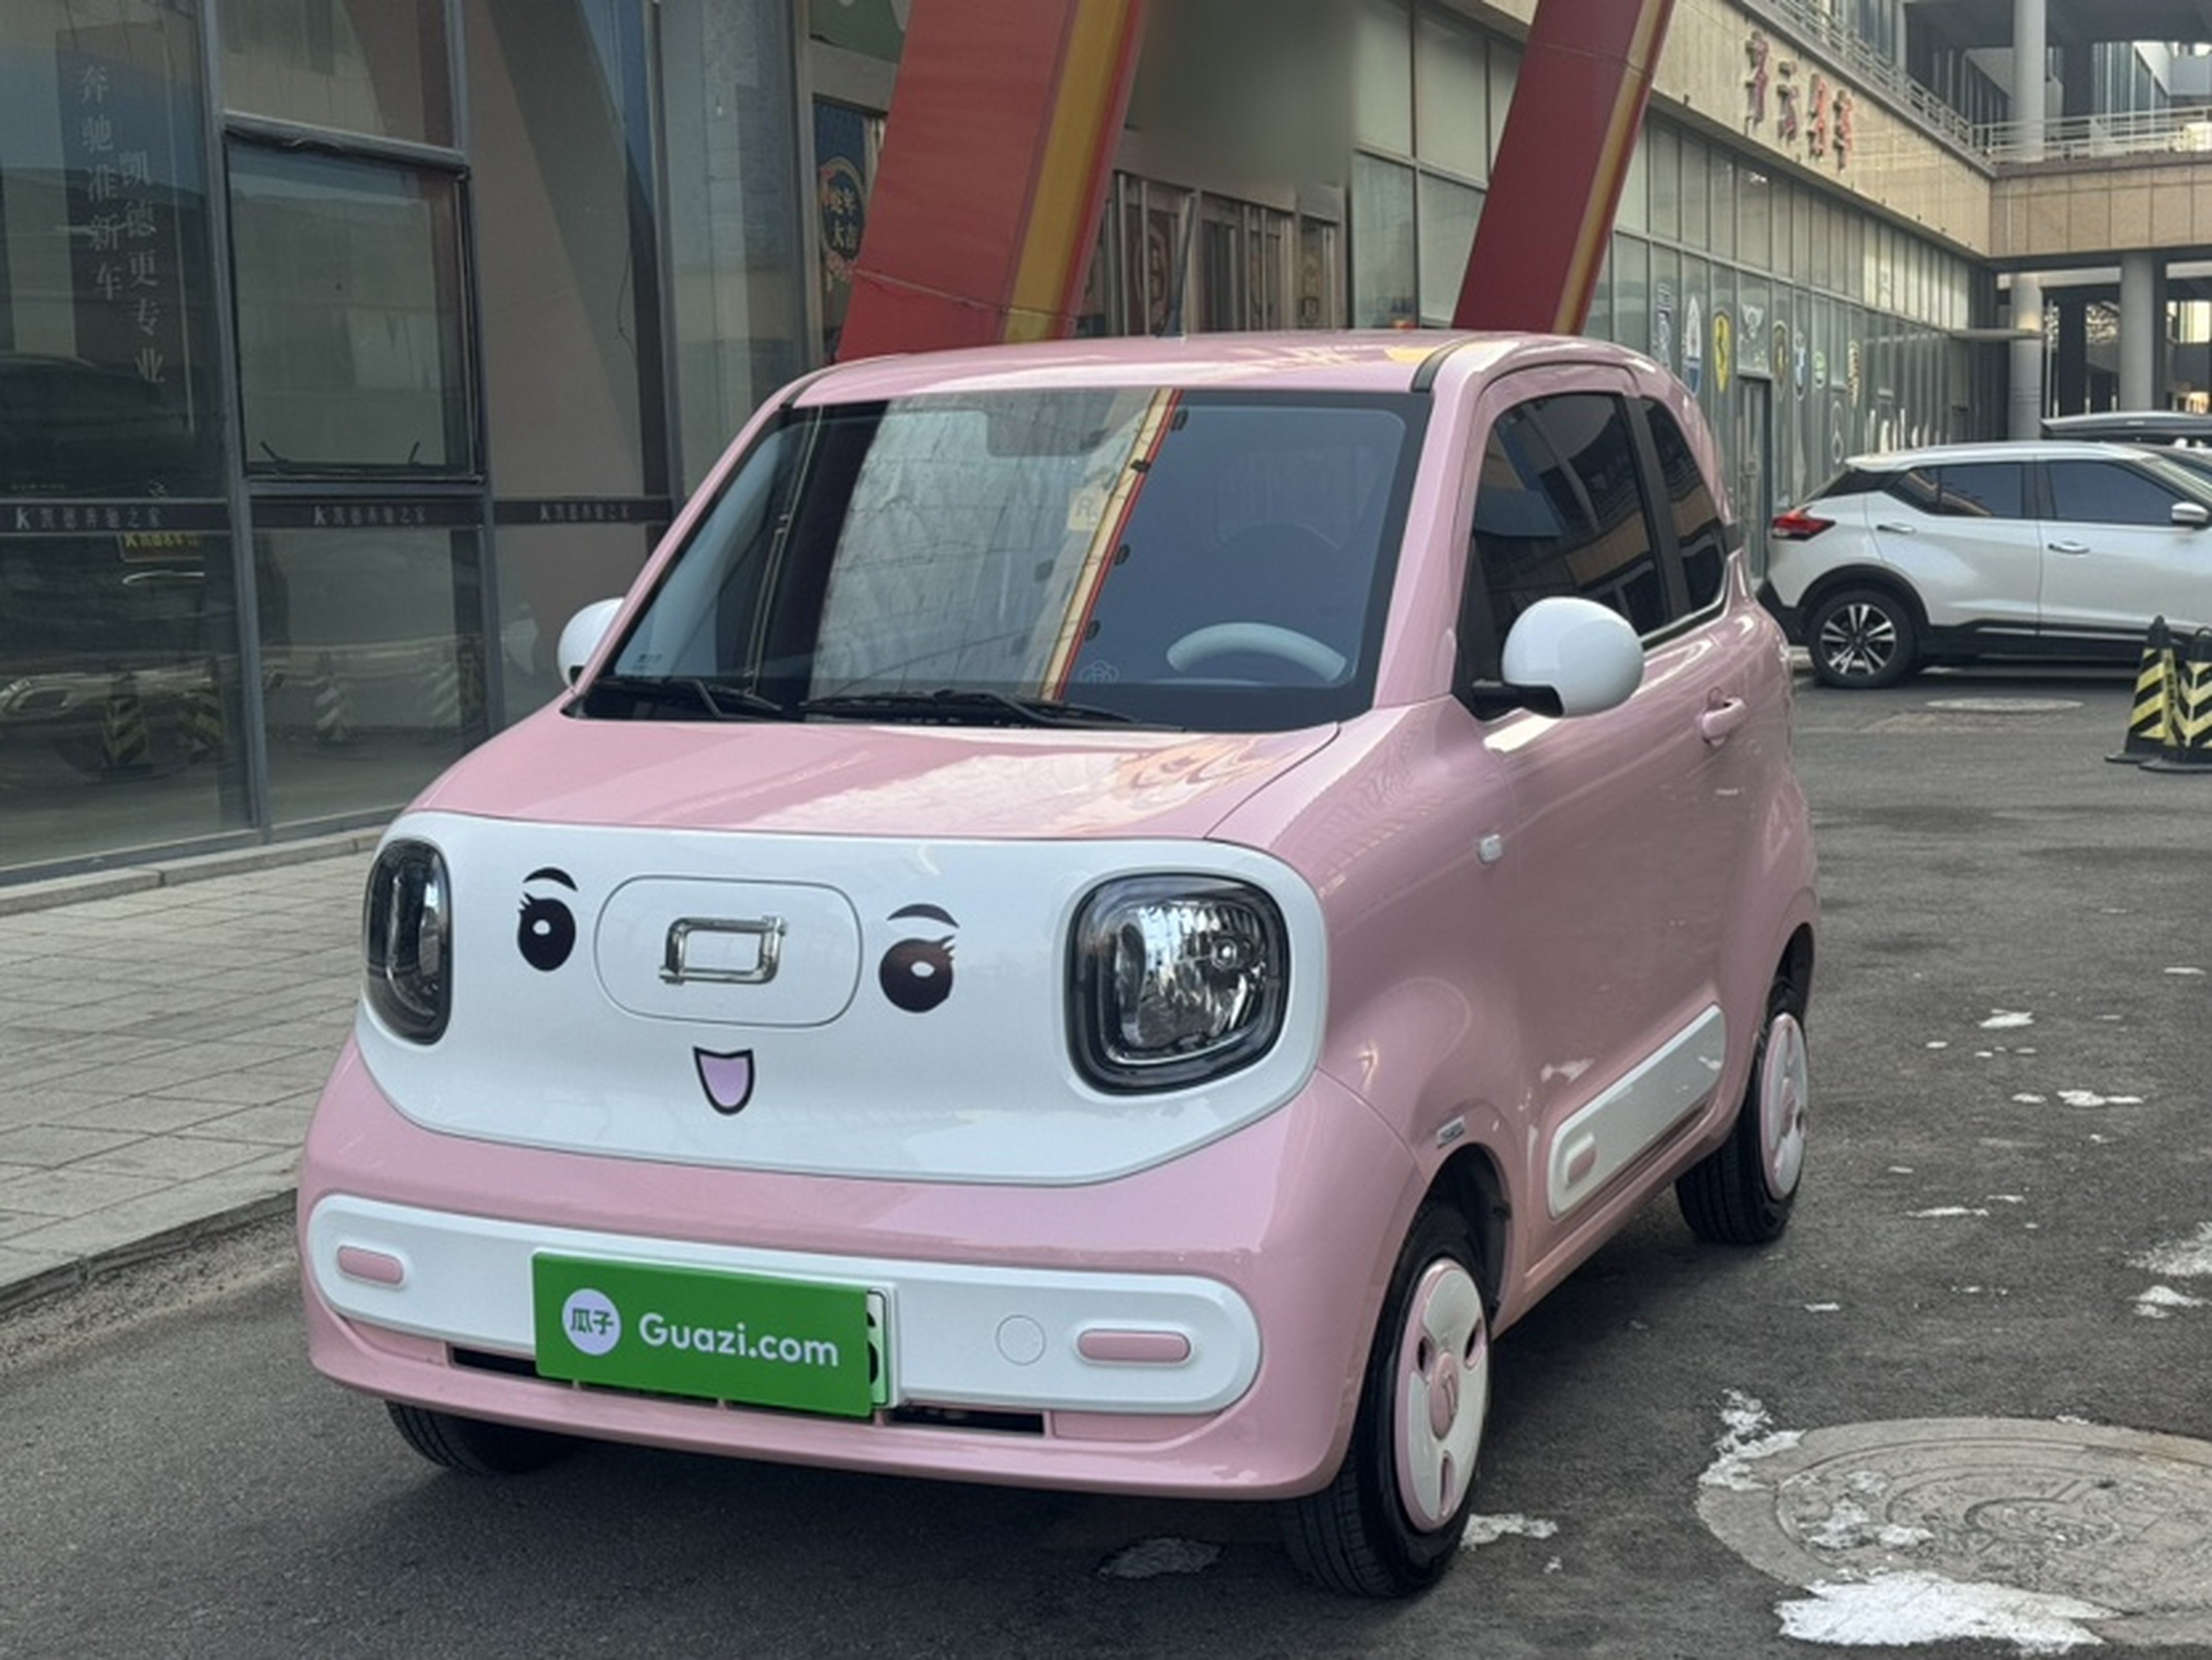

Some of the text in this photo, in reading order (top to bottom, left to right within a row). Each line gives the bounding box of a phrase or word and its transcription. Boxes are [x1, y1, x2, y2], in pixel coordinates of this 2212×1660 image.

[79, 65, 122, 301] 奔驰准新车
[119, 150, 166, 384] 凯德更专业
